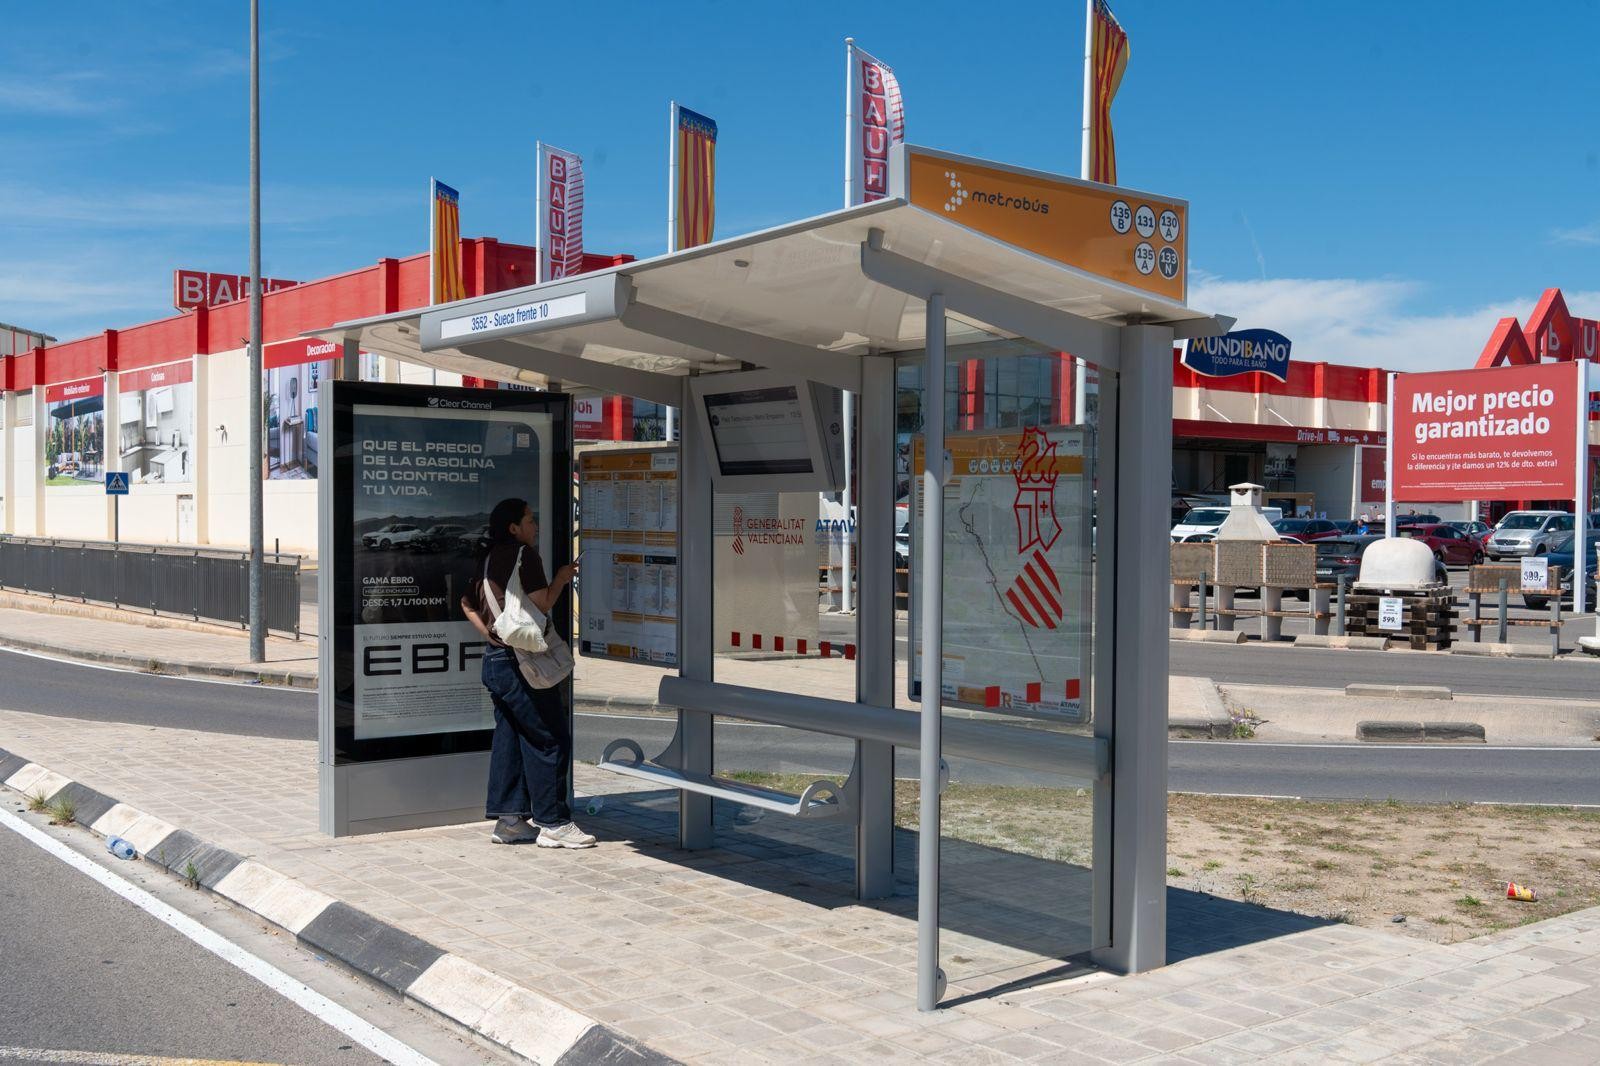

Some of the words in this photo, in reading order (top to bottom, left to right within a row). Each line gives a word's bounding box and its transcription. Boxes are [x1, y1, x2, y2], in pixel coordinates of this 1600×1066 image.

[864, 67, 884, 190] BAUH
[972, 190, 1049, 214] metrobús
[1113, 206, 1130, 220] 135
[1118, 219, 1125, 230] B
[1137, 215, 1154, 228] 131
[1161, 216, 1177, 228] 130
[1165, 228, 1172, 239] A
[1137, 249, 1154, 260] 135
[1160, 252, 1177, 264] 133
[1141, 260, 1148, 271] A
[1165, 264, 1172, 275] N
[472, 315, 488, 331] 3552
[494, 313, 515, 327] Sueca
[516, 308, 537, 322] frente
[539, 303, 548, 318] 10
[306, 341, 336, 357] Decoración
[1211, 356, 1228, 365] TODO
[1229, 358, 1243, 366] PARA
[1244, 359, 1250, 367] EL
[1252, 359, 1267, 369] BAÑO
[439, 399, 460, 408] Clear
[461, 400, 492, 410] Channel
[1412, 390, 1477, 416] Mejor
[1483, 384, 1554, 414] precio
[1414, 412, 1550, 444] garantizado
[1297, 430, 1324, 443] Drive-In
[362, 440, 397, 452] QUE
[401, 441, 422, 452] EL
[425, 442, 482, 454] PRECIO
[1411, 453, 1418, 461] Si
[1419, 452, 1425, 461] lo
[1463, 452, 1477, 460] más
[1478, 451, 1501, 460] barato,
[1503, 451, 1511, 459] te
[1512, 449, 1553, 458] devolvemos
[362, 455, 386, 466] DE
[390, 456, 411, 467] LA
[415, 456, 495, 469] GASOLINA
[1407, 462, 1413, 471] la
[1414, 462, 1446, 471] diferencia
[1446, 464, 1451, 472] y
[1452, 462, 1461, 471] ¡te
[1462, 461, 1485, 470] damos
[1496, 461, 1509, 469] 12%
[1511, 460, 1520, 469] de
[1521, 460, 1535, 469] dto.
[1537, 459, 1558, 468] extra!
[362, 470, 387, 481] NO
[391, 470, 479, 483] CONTROLE
[362, 485, 385, 496] TU
[389, 485, 432, 496] VIDA.
[747, 519, 806, 530] GENERALITAT
[747, 533, 804, 545] VALENCIANA
[362, 577, 389, 585] GAMA
[390, 576, 414, 584] EBRO
[362, 599, 389, 607] DESDE
[390, 598, 402, 607] 1,7
[403, 597, 428, 606] L/100
